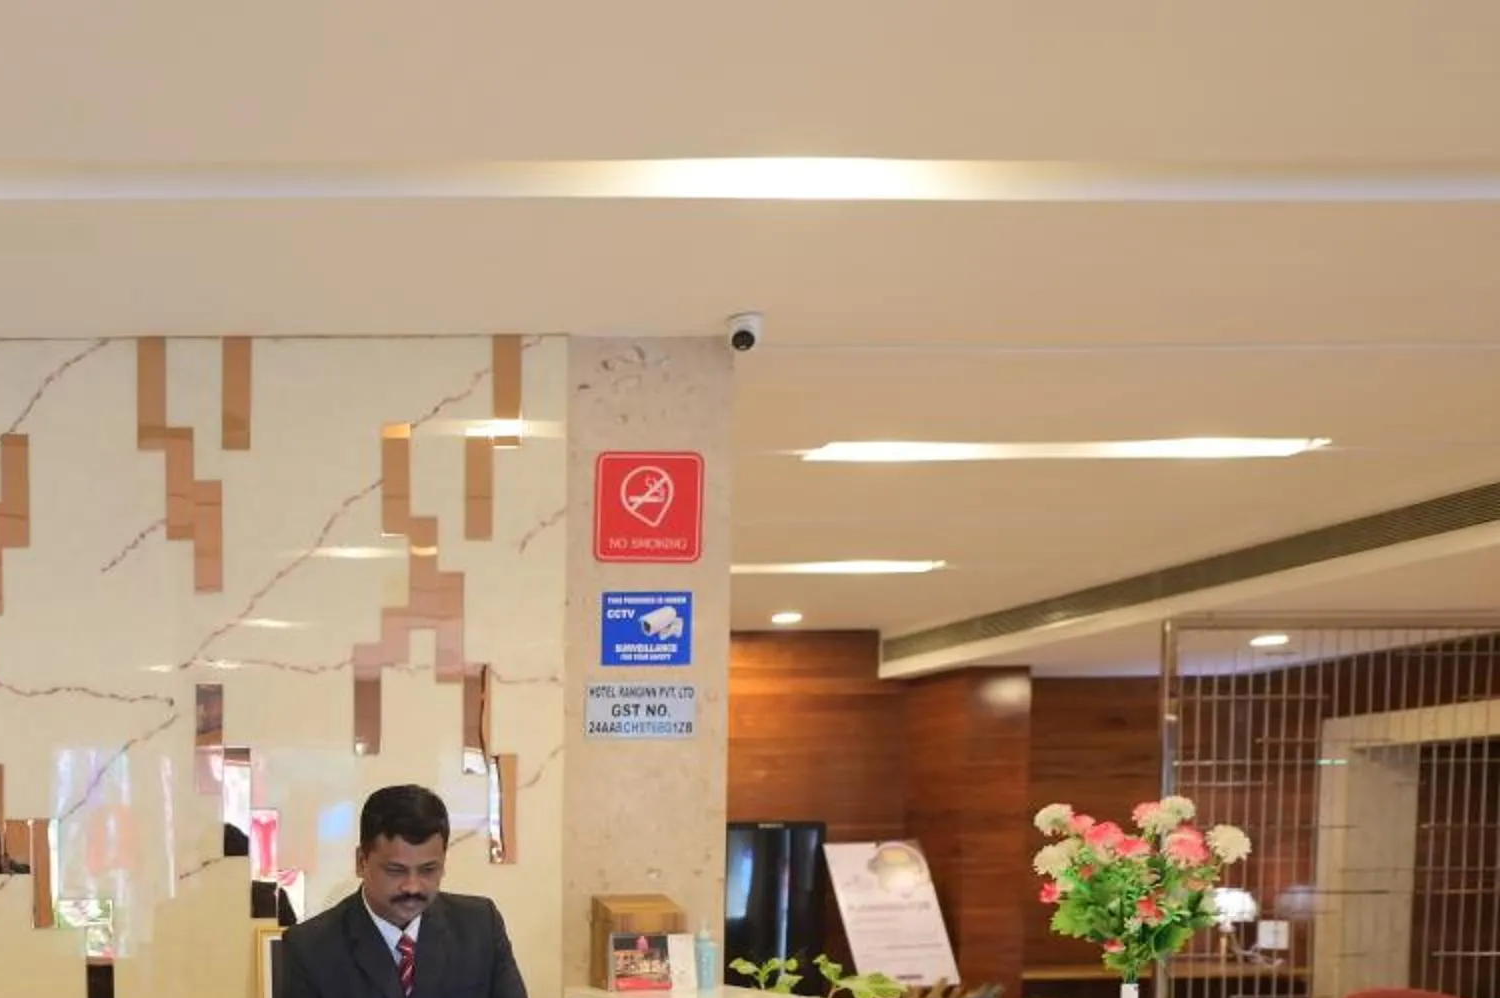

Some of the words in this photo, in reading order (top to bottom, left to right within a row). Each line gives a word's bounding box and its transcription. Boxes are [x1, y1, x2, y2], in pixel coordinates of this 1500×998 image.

[609, 538, 628, 549] NO
[631, 537, 688, 550] SMOKING
[607, 608, 636, 619] CCTV
[615, 643, 678, 653] SURVEILLANCE
[589, 685, 616, 698] HOTEL
[611, 704, 641, 717] GST
[645, 703, 672, 718] NO.
